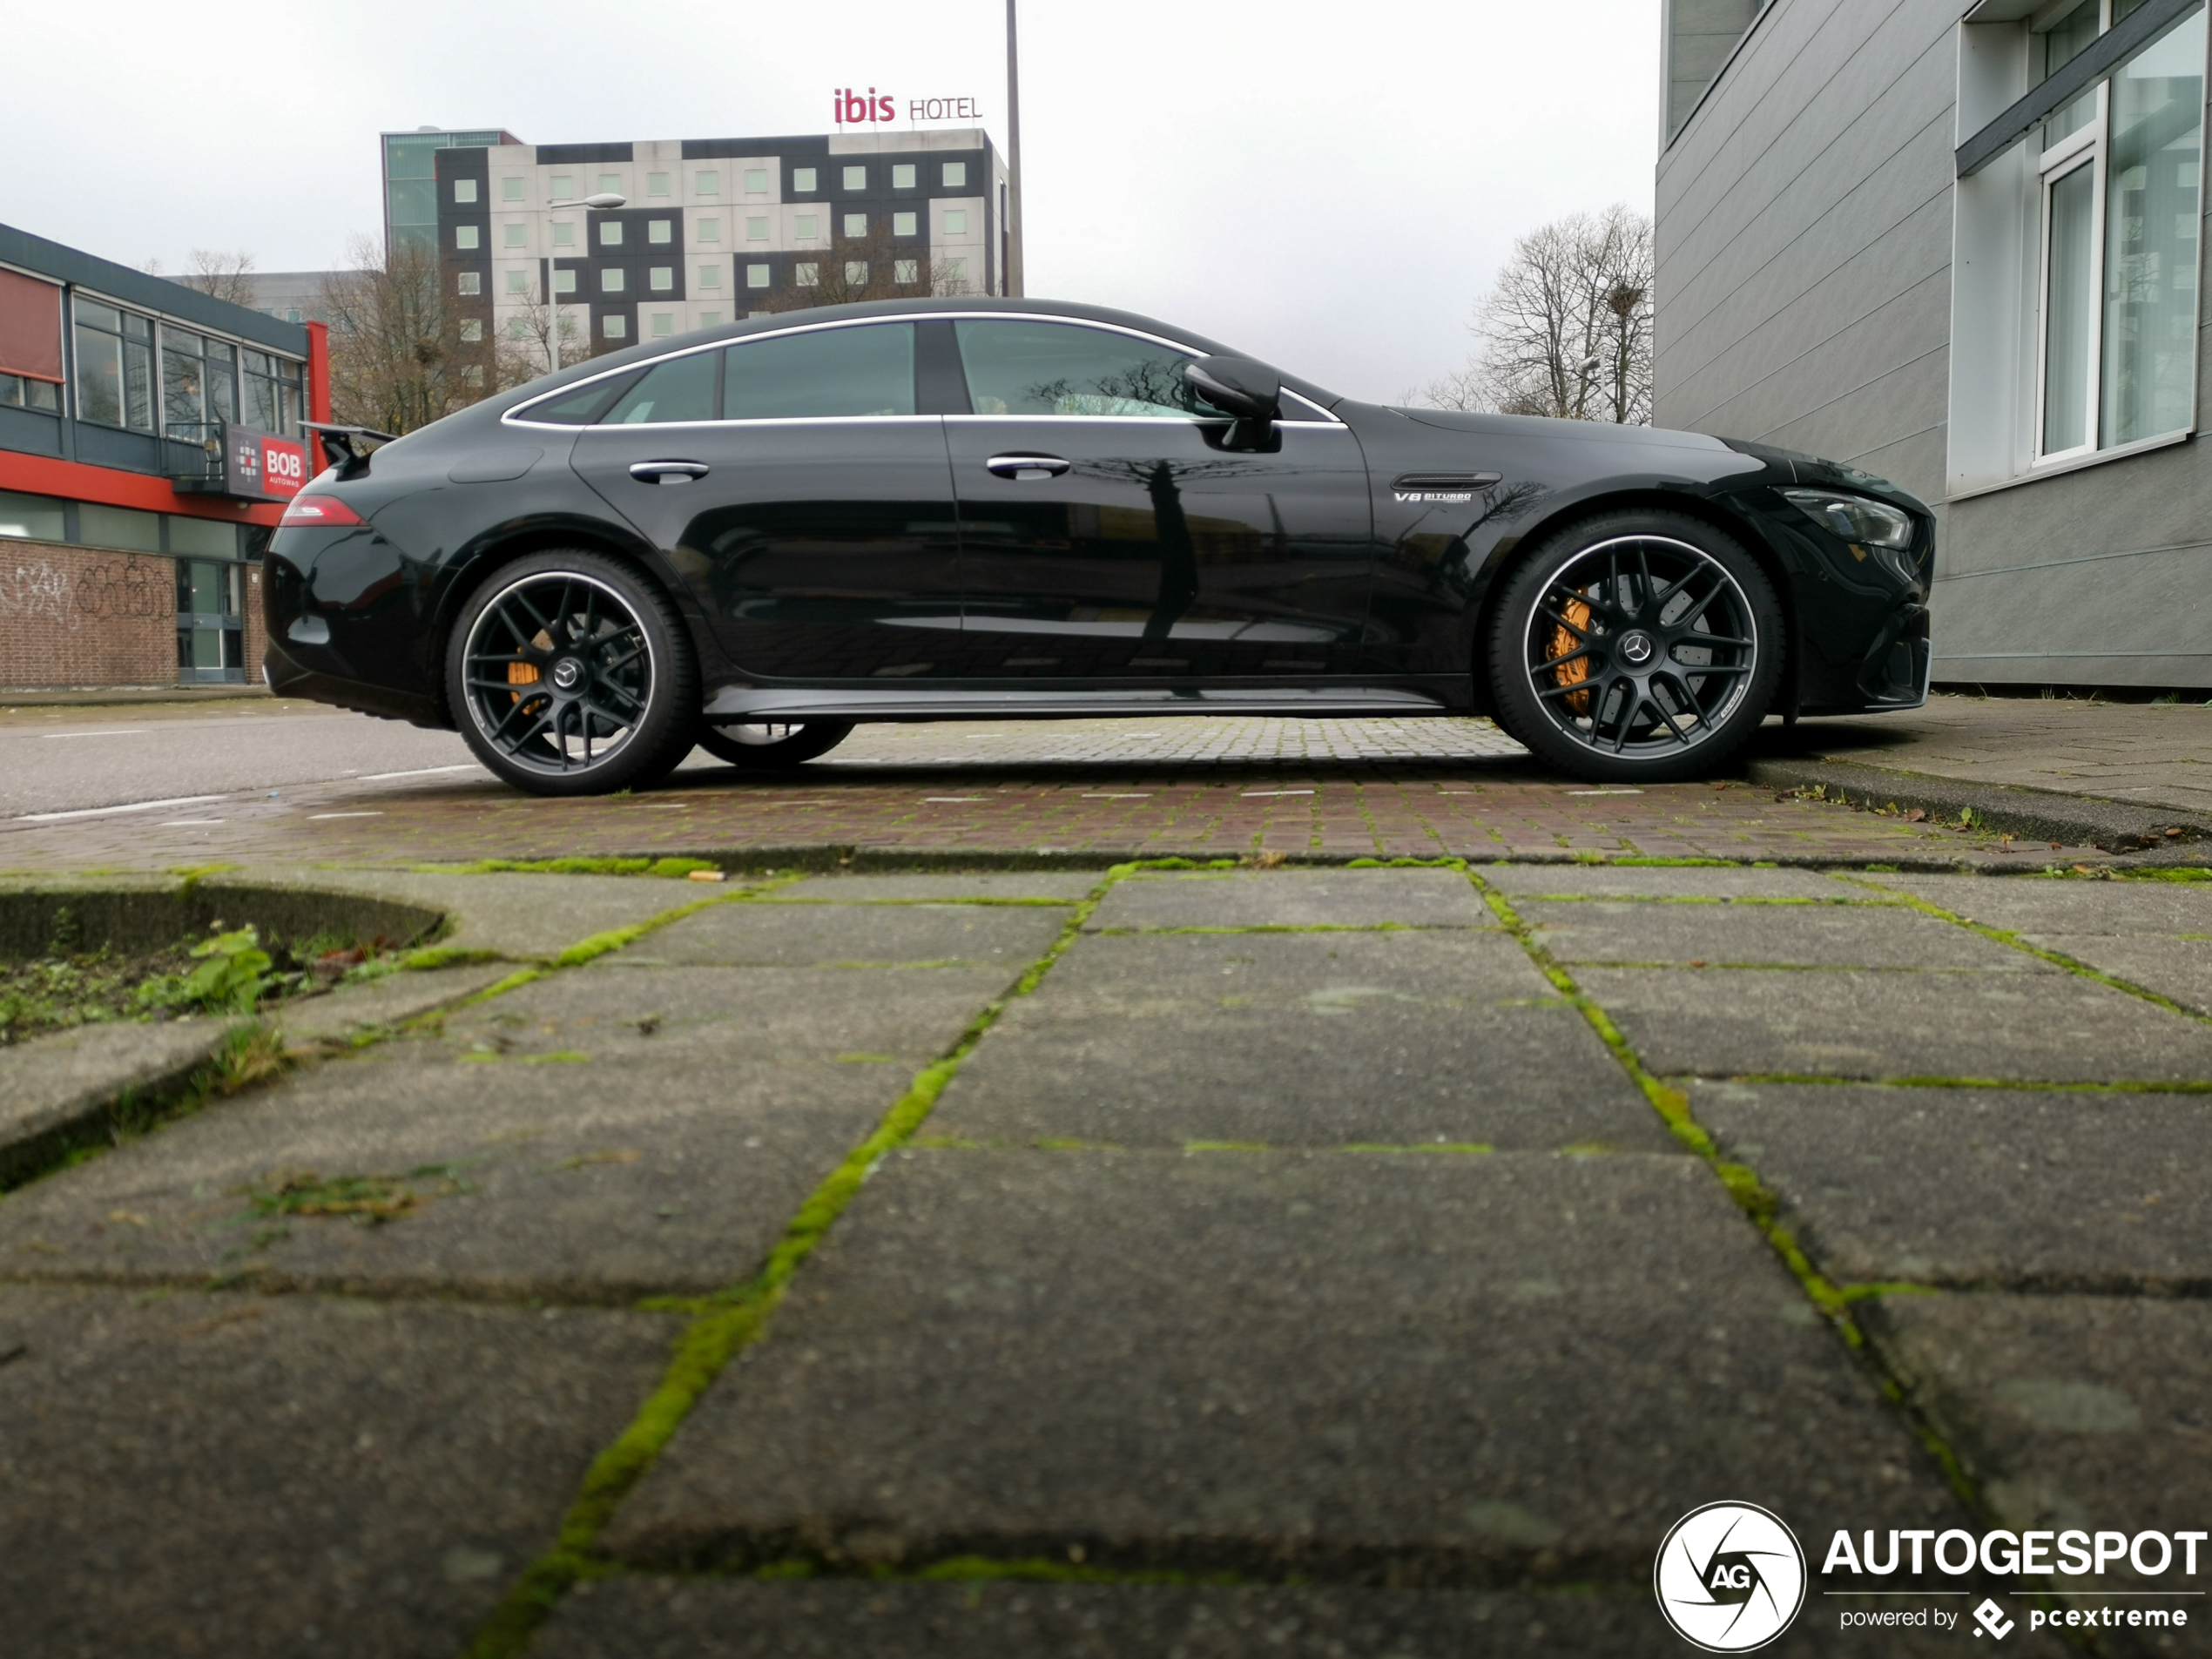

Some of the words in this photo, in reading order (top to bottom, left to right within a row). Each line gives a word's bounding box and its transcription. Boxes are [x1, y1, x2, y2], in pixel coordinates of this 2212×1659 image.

[834, 87, 895, 124] ibis
[910, 97, 983, 119] HOTEL
[266, 449, 301, 478] BOB
[269, 475, 300, 488] AUTOWAS
[1394, 492, 1421, 502] V8
